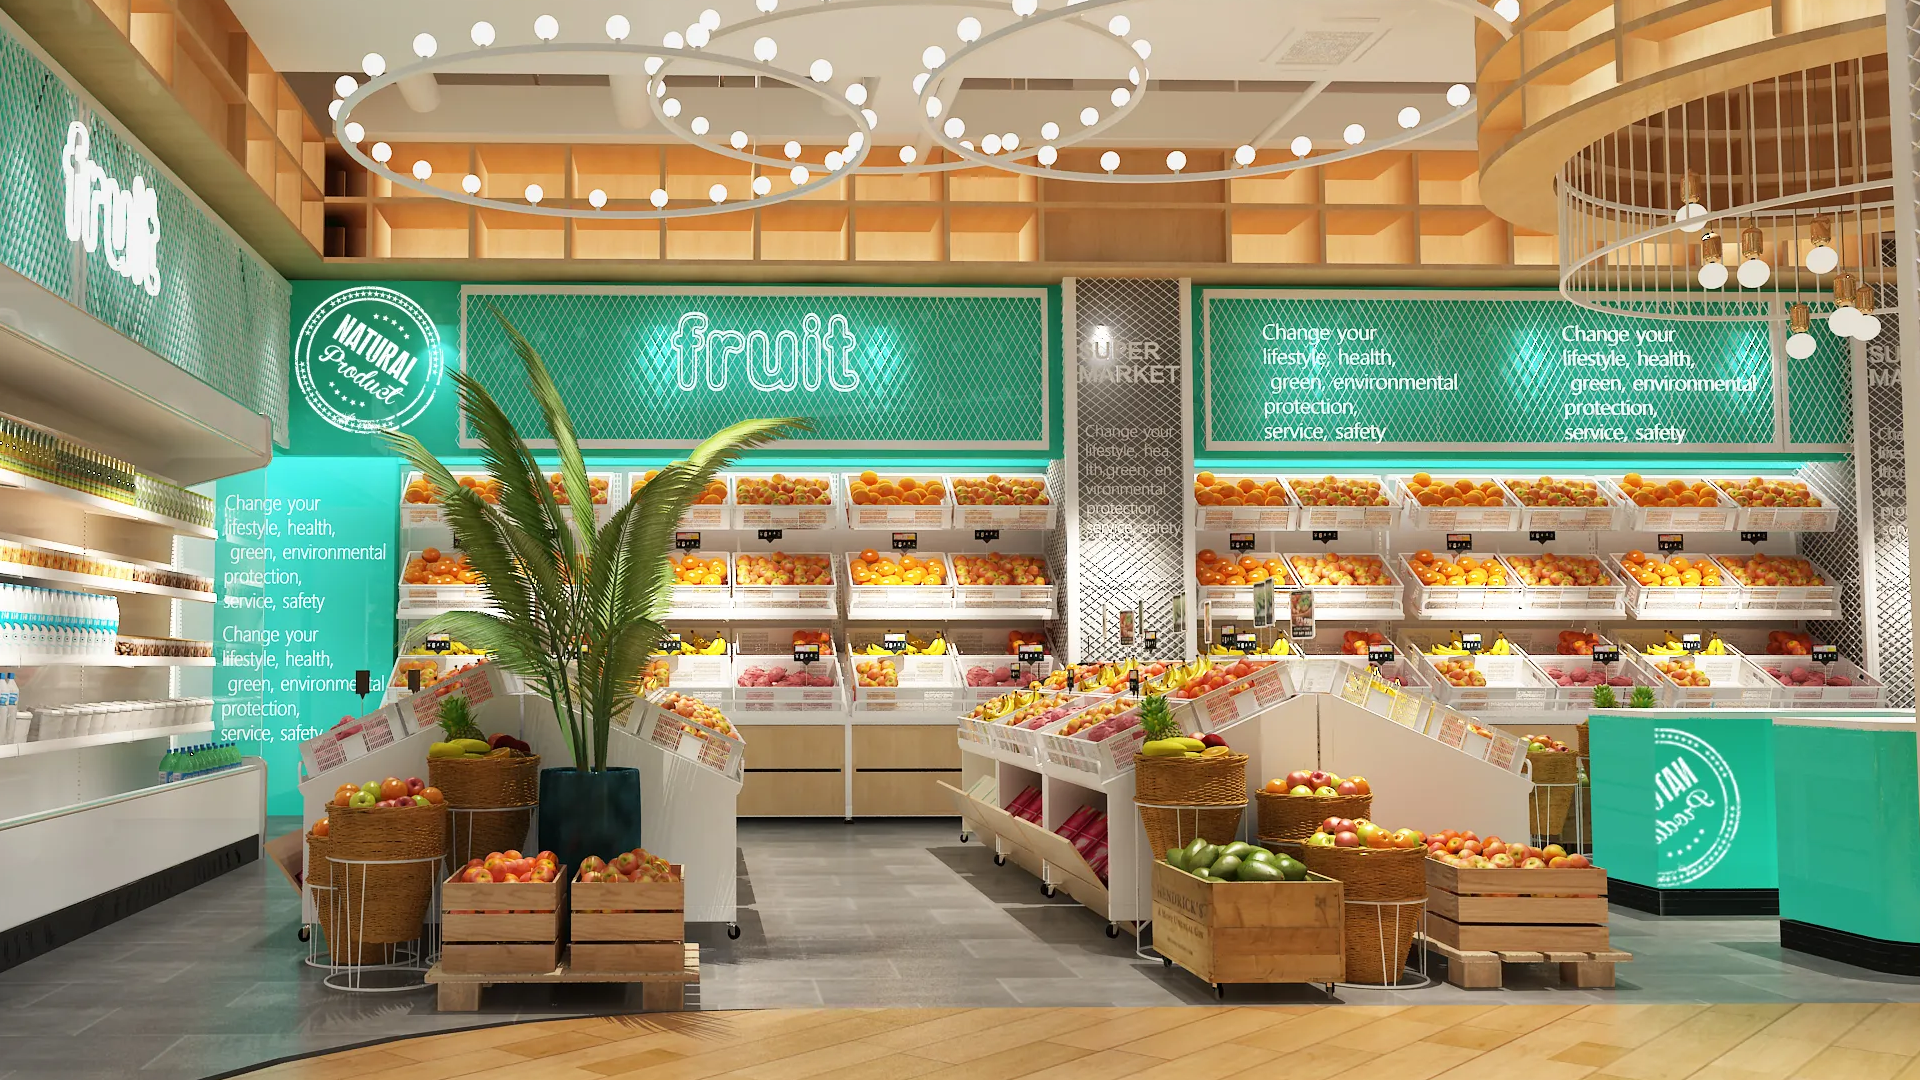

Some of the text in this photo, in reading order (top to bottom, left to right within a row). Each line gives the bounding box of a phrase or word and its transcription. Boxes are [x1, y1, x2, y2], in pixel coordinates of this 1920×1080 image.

[1262, 323, 1377, 345] Change your
[1562, 325, 1676, 346] Change your
[332, 313, 418, 387] NATURAL
[671, 311, 860, 392] fruit
[1078, 341, 1161, 361] SUPER
[1263, 348, 1396, 369] lifestyle, health,
[1563, 350, 1695, 371] lifestyle, health,
[318, 344, 406, 405] Product
[1078, 365, 1180, 384] MARKET
[1271, 373, 1458, 394] green, environmental
[1571, 375, 1758, 395] green, environmental
[1264, 399, 1358, 418] protection,
[1564, 400, 1657, 419] protection,
[1085, 424, 1174, 443] Change your
[1264, 422, 1386, 444] service, safety
[1564, 424, 1686, 445] service, safety
[1085, 443, 1138, 461] lifestyle,
[1155, 466, 1172, 476] en
[1086, 482, 1167, 496] vironmental
[225, 494, 321, 515] Change your
[1087, 503, 1159, 518] protection,
[225, 518, 336, 539] lifestyle, health,
[1142, 521, 1181, 536] safety
[230, 543, 387, 564] green, environmental
[224, 569, 302, 589] protection,
[223, 593, 325, 613] service, safety
[222, 626, 319, 646] Change your
[222, 650, 334, 671] lifestyle, health,
[228, 675, 386, 696] green, environmetal
[221, 701, 300, 720] protection,
[221, 727, 274, 743] service,
